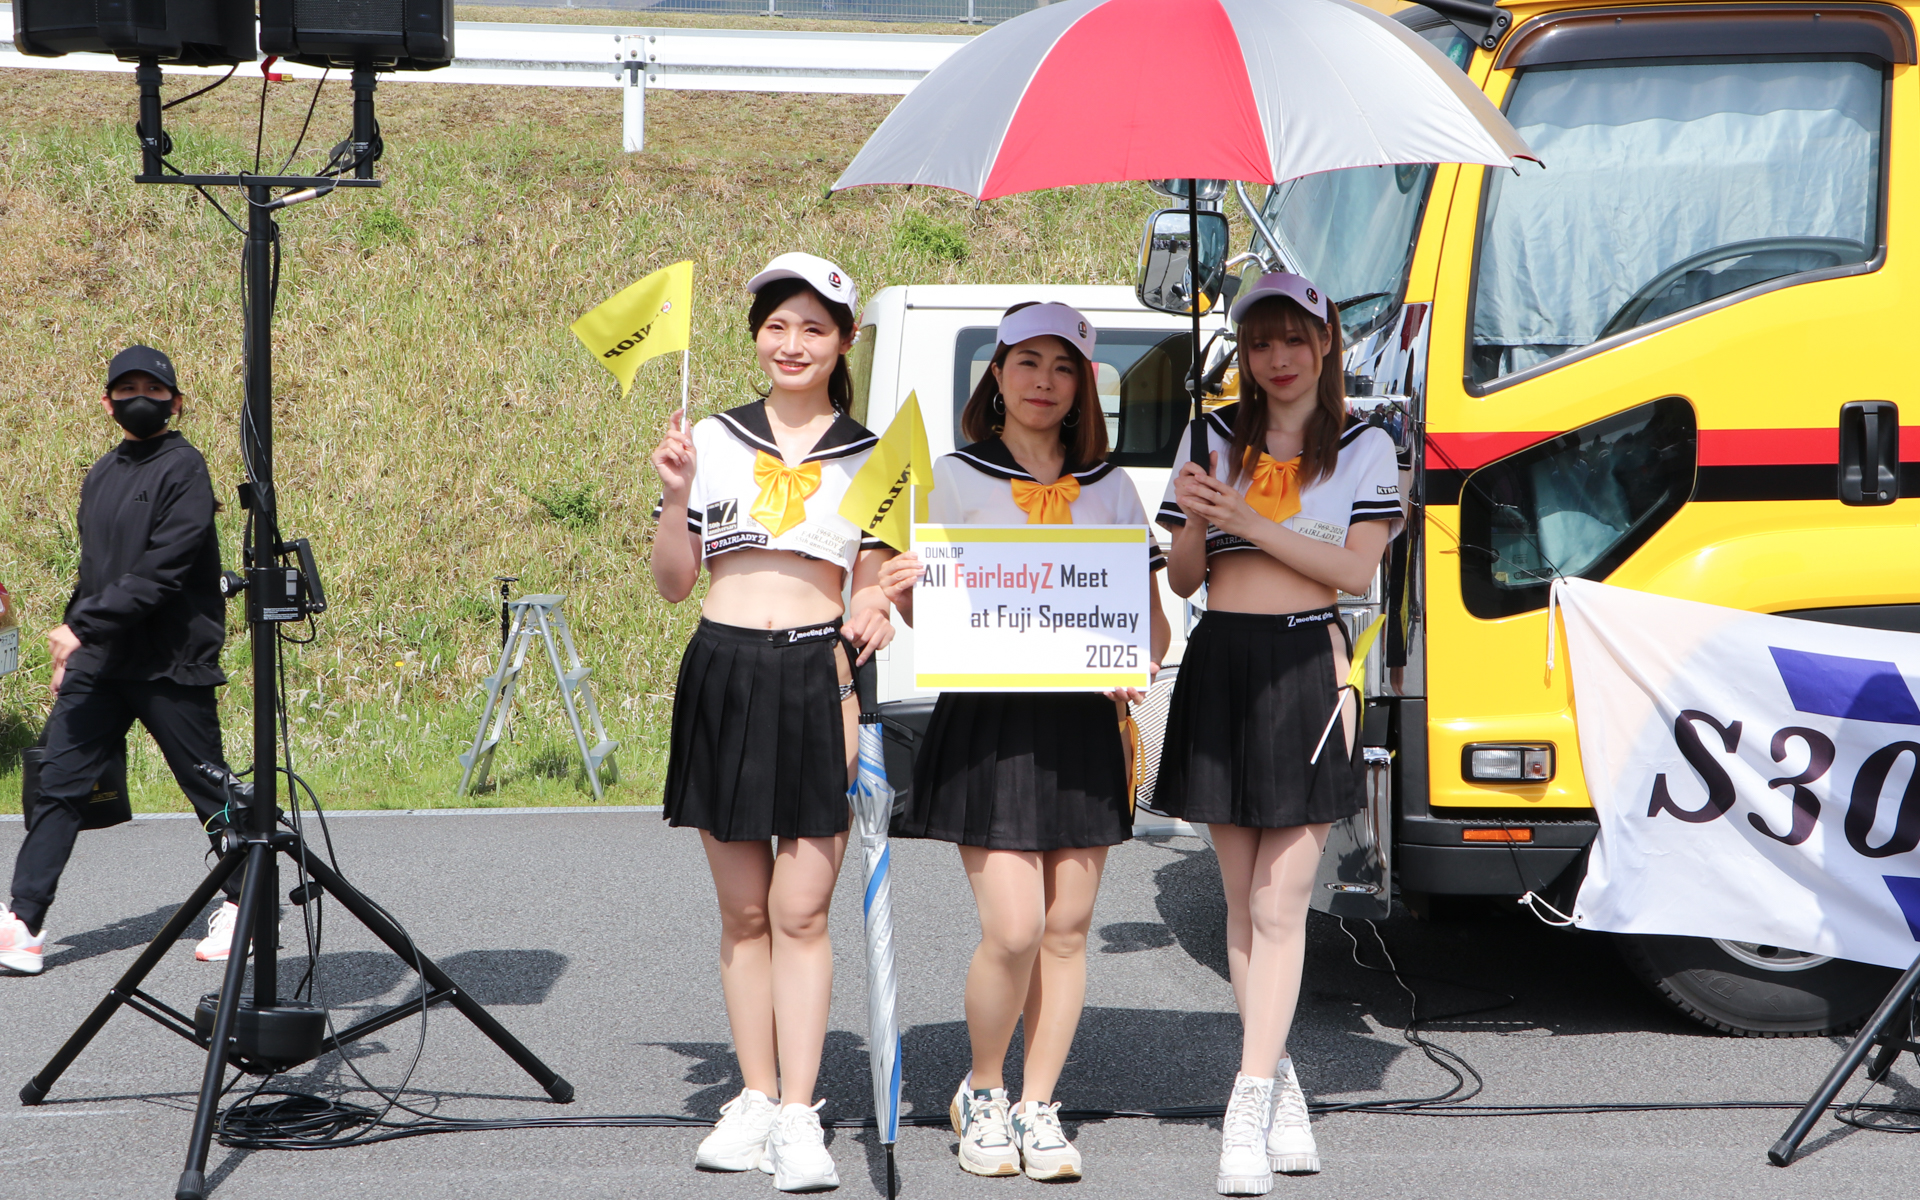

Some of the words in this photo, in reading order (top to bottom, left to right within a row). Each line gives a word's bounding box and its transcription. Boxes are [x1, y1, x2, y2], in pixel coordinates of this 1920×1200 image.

[720, 499, 738, 526] Z
[816, 528, 846, 545] 1969-2024
[1298, 527, 1336, 541] FAIRLADY
[1313, 522, 1344, 535] 1969-2024
[719, 534, 757, 548] FAIRLADY
[757, 535, 766, 544] Z
[801, 530, 839, 549] FAIRLADY
[925, 546, 964, 559] DUNLOP
[922, 563, 947, 588] All
[954, 562, 1054, 594] FairladyZ
[1060, 564, 1108, 588] Meet
[971, 608, 990, 628] at
[997, 604, 1031, 633] Fuji
[1039, 604, 1139, 633] Speedway
[1086, 644, 1138, 668] 2025
[1647, 709, 1920, 858] S30
